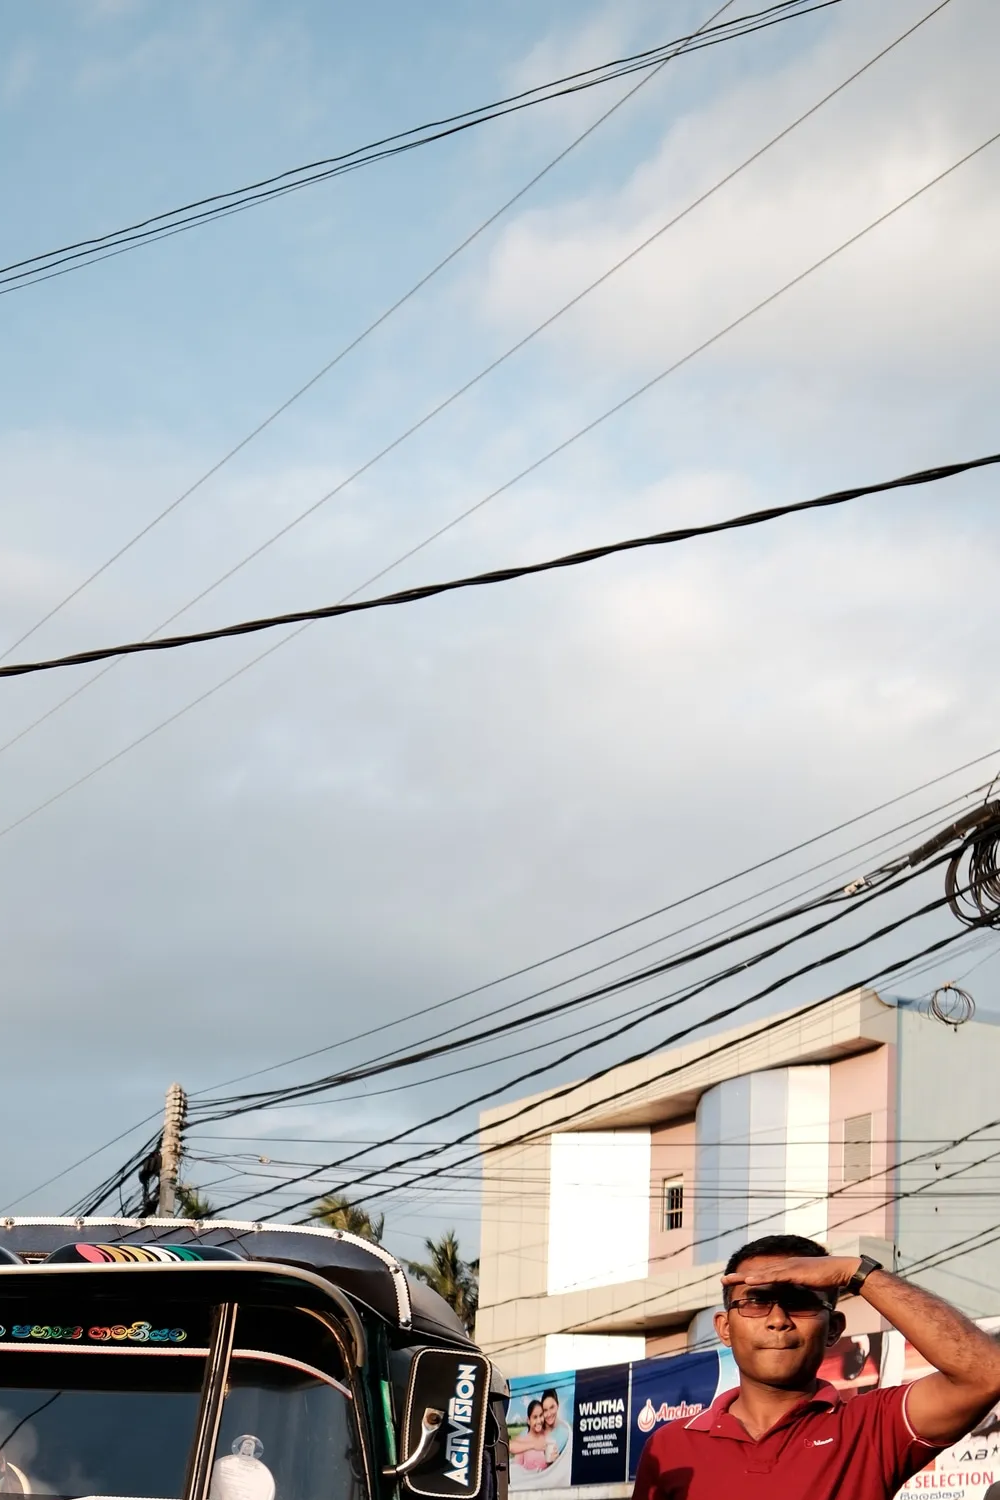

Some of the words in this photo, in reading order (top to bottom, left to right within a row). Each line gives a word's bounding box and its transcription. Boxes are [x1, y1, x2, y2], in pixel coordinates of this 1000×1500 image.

[579, 1398, 625, 1417] WIJITHA
[656, 1400, 703, 1422] Anchor
[443, 1364, 478, 1487] ACTIVISION
[579, 1414, 623, 1432] STORES
[914, 1471, 994, 1489] SELECTION
